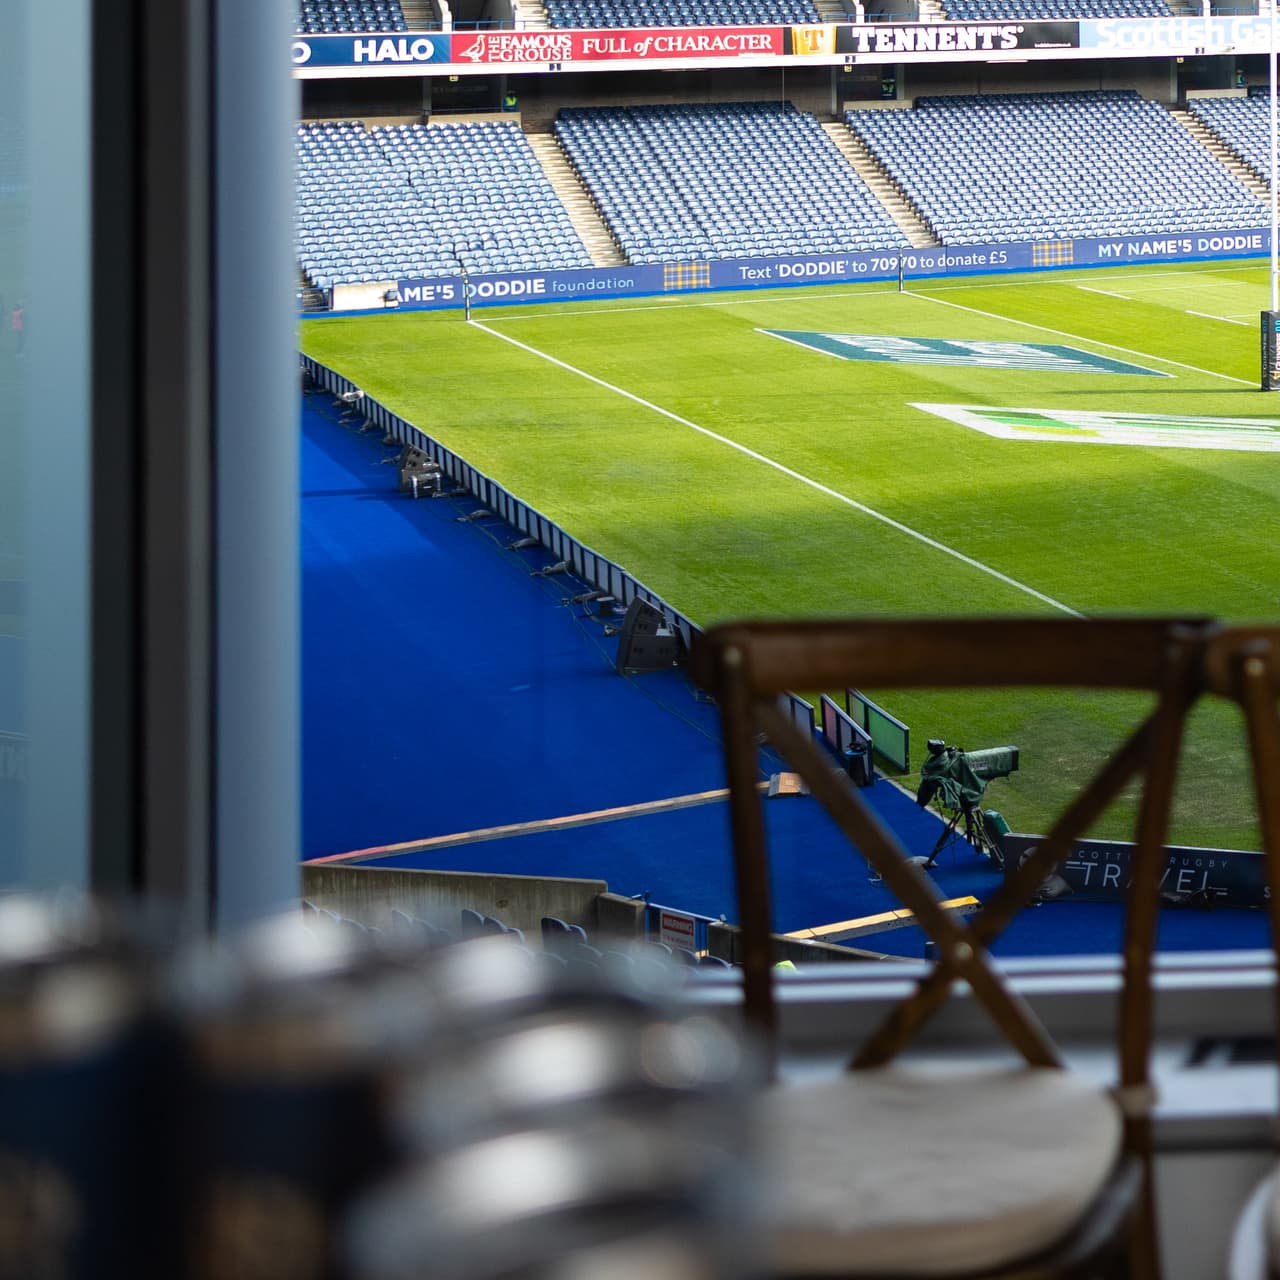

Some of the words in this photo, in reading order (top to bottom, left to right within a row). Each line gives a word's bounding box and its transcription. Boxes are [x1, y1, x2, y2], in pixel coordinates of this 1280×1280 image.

[500, 34, 573, 50] FAMOUS
[581, 36, 633, 55] FULL
[633, 37, 653, 57] of
[653, 33, 773, 53] CHARACTER
[851, 24, 1021, 52] TENNENT'S
[1095, 19, 1225, 49] Scottish
[353, 38, 435, 63] HALO
[487, 35, 501, 62] THE
[500, 47, 573, 61] GROUSE
[1098, 242, 1124, 259] MY
[1197, 235, 1263, 253] DODDIE
[738, 265, 773, 281] Text
[851, 259, 868, 274] to
[870, 254, 918, 273] 70970
[919, 254, 936, 269] to
[937, 252, 986, 269] donate
[988, 250, 1008, 265] £5
[462, 278, 546, 300] DODDIE
[551, 276, 635, 294] foundation
[1169, 856, 1229, 869] RUGBY
